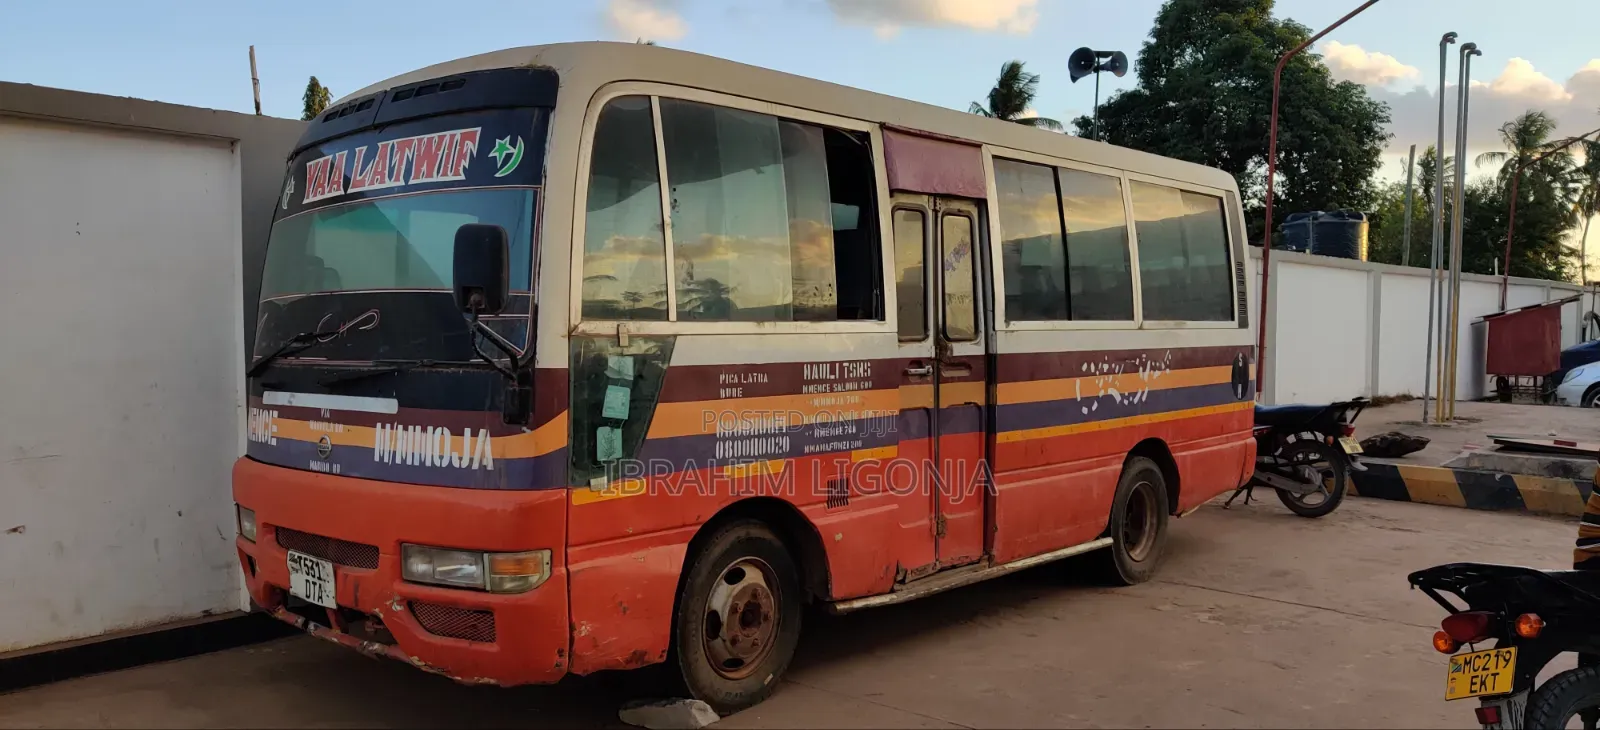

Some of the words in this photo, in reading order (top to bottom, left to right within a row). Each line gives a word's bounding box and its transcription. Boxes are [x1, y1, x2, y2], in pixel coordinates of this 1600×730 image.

[302, 150, 348, 204] YAA
[347, 127, 482, 193] LATWIF
[297, 555, 323, 581] T531
[305, 579, 323, 604] DTA
[1462, 650, 1513, 675] MC219
[1469, 672, 1500, 694] EKT
